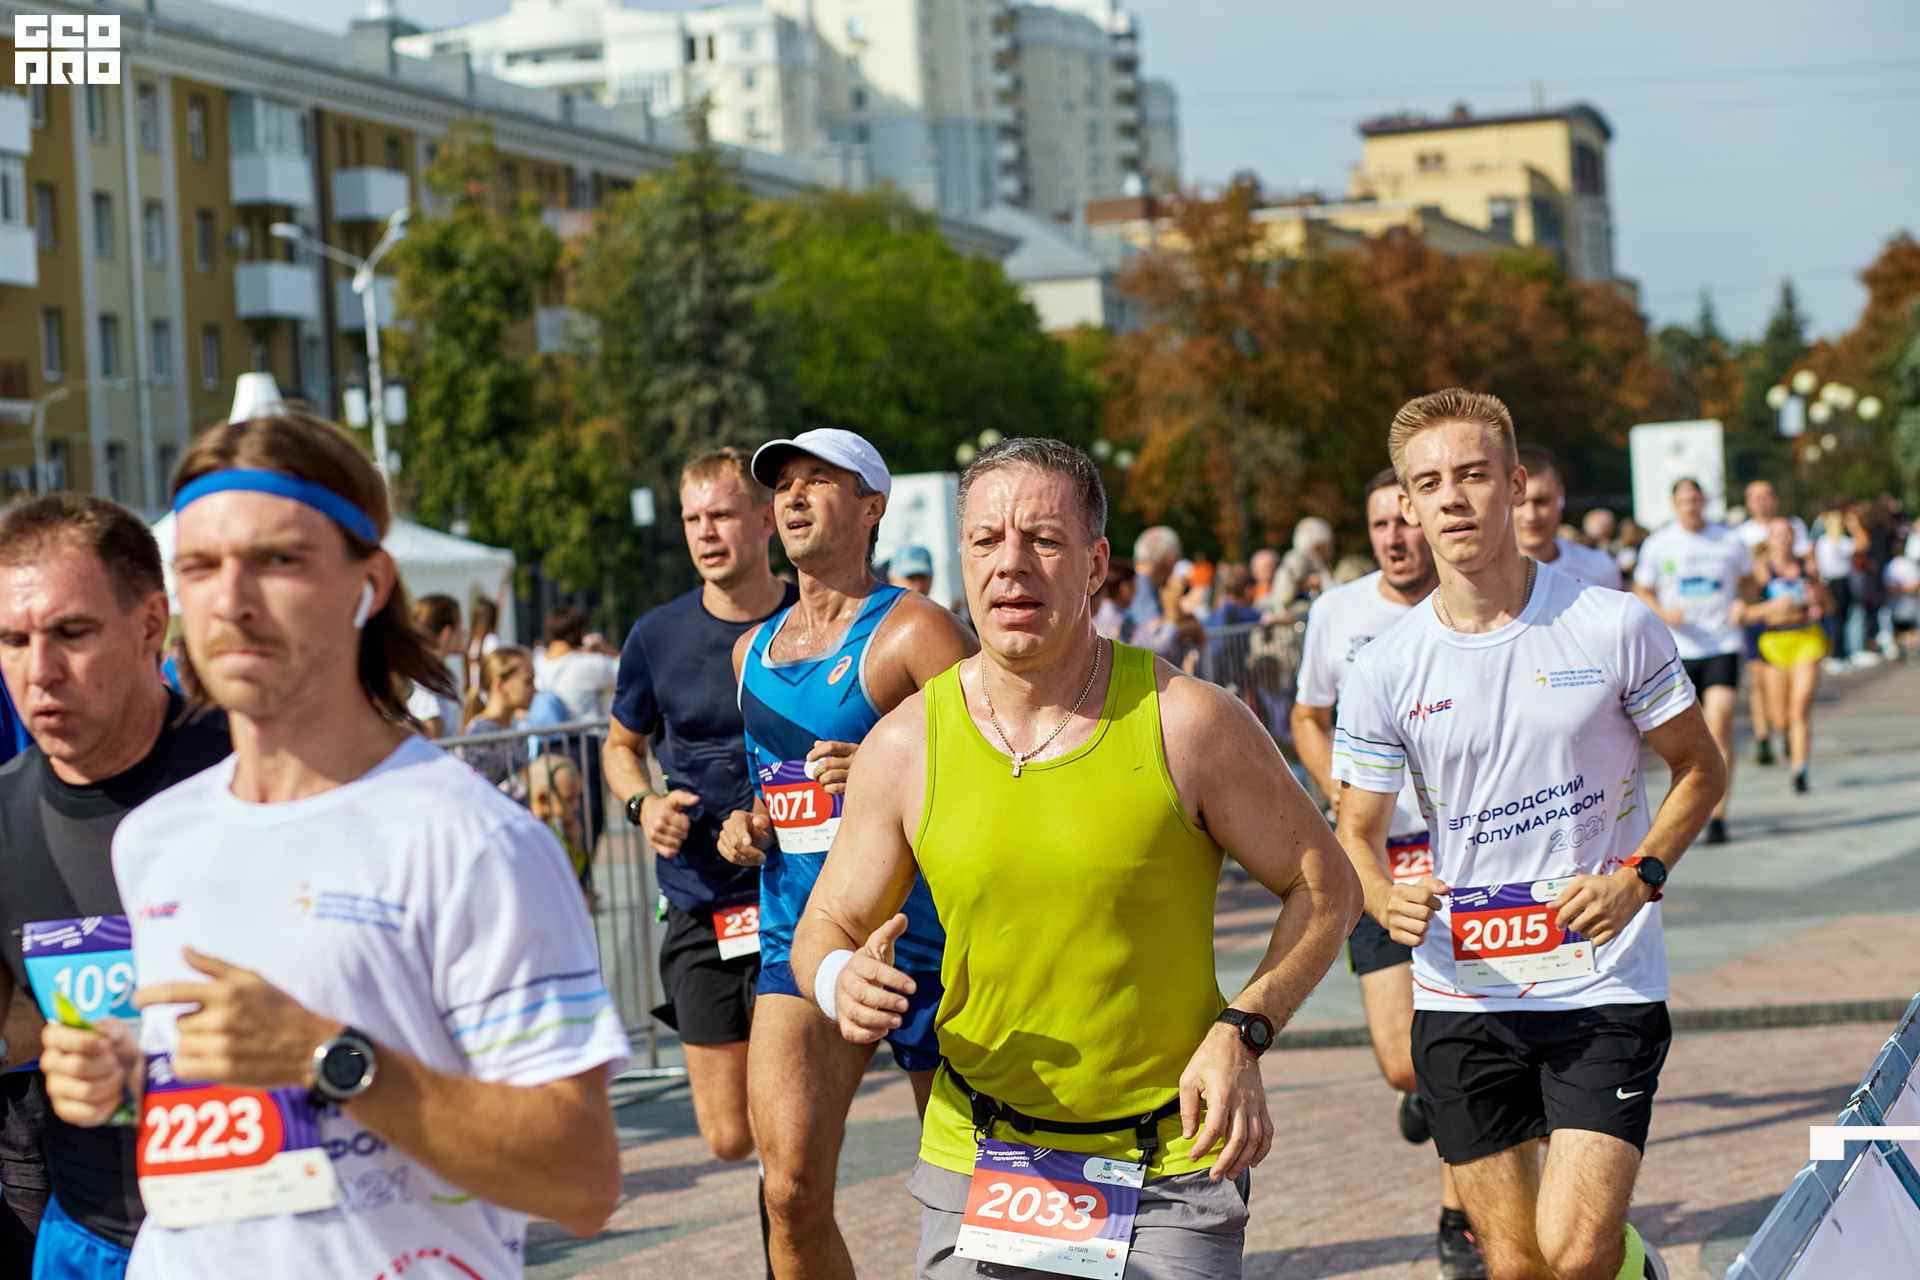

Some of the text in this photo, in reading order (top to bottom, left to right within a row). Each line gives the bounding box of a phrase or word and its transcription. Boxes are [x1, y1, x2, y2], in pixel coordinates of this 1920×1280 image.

[766, 789, 817, 822] 2071
[1550, 810, 1608, 853] 2021
[723, 907, 760, 937] 23
[1461, 913, 1549, 952] 2015
[54, 962, 134, 1010] 109
[144, 1096, 265, 1164] 2223
[976, 1182, 1098, 1231] 2033
